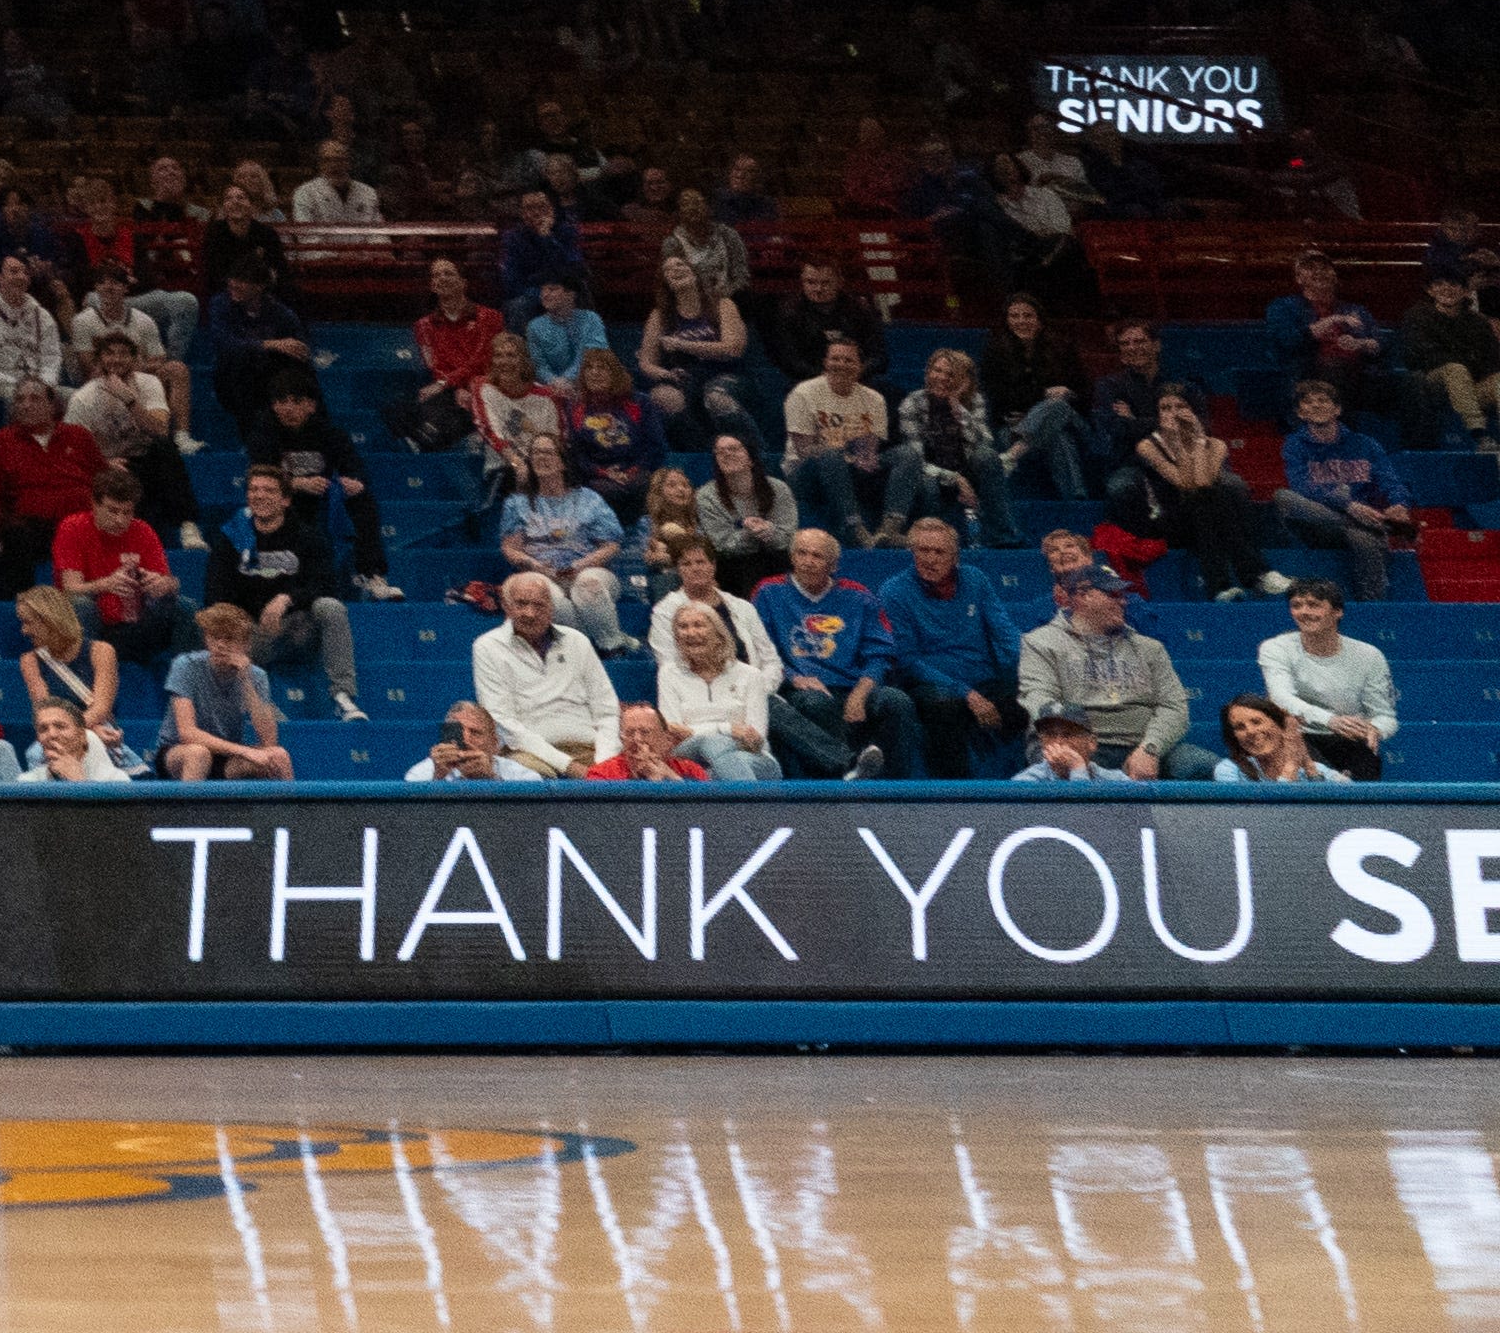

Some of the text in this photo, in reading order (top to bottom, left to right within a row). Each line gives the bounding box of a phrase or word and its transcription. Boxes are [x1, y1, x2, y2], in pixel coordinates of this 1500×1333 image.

[1045, 65, 1258, 94] THANK YOU
[149, 826, 799, 962] THANK
[856, 825, 1255, 964] YOU
